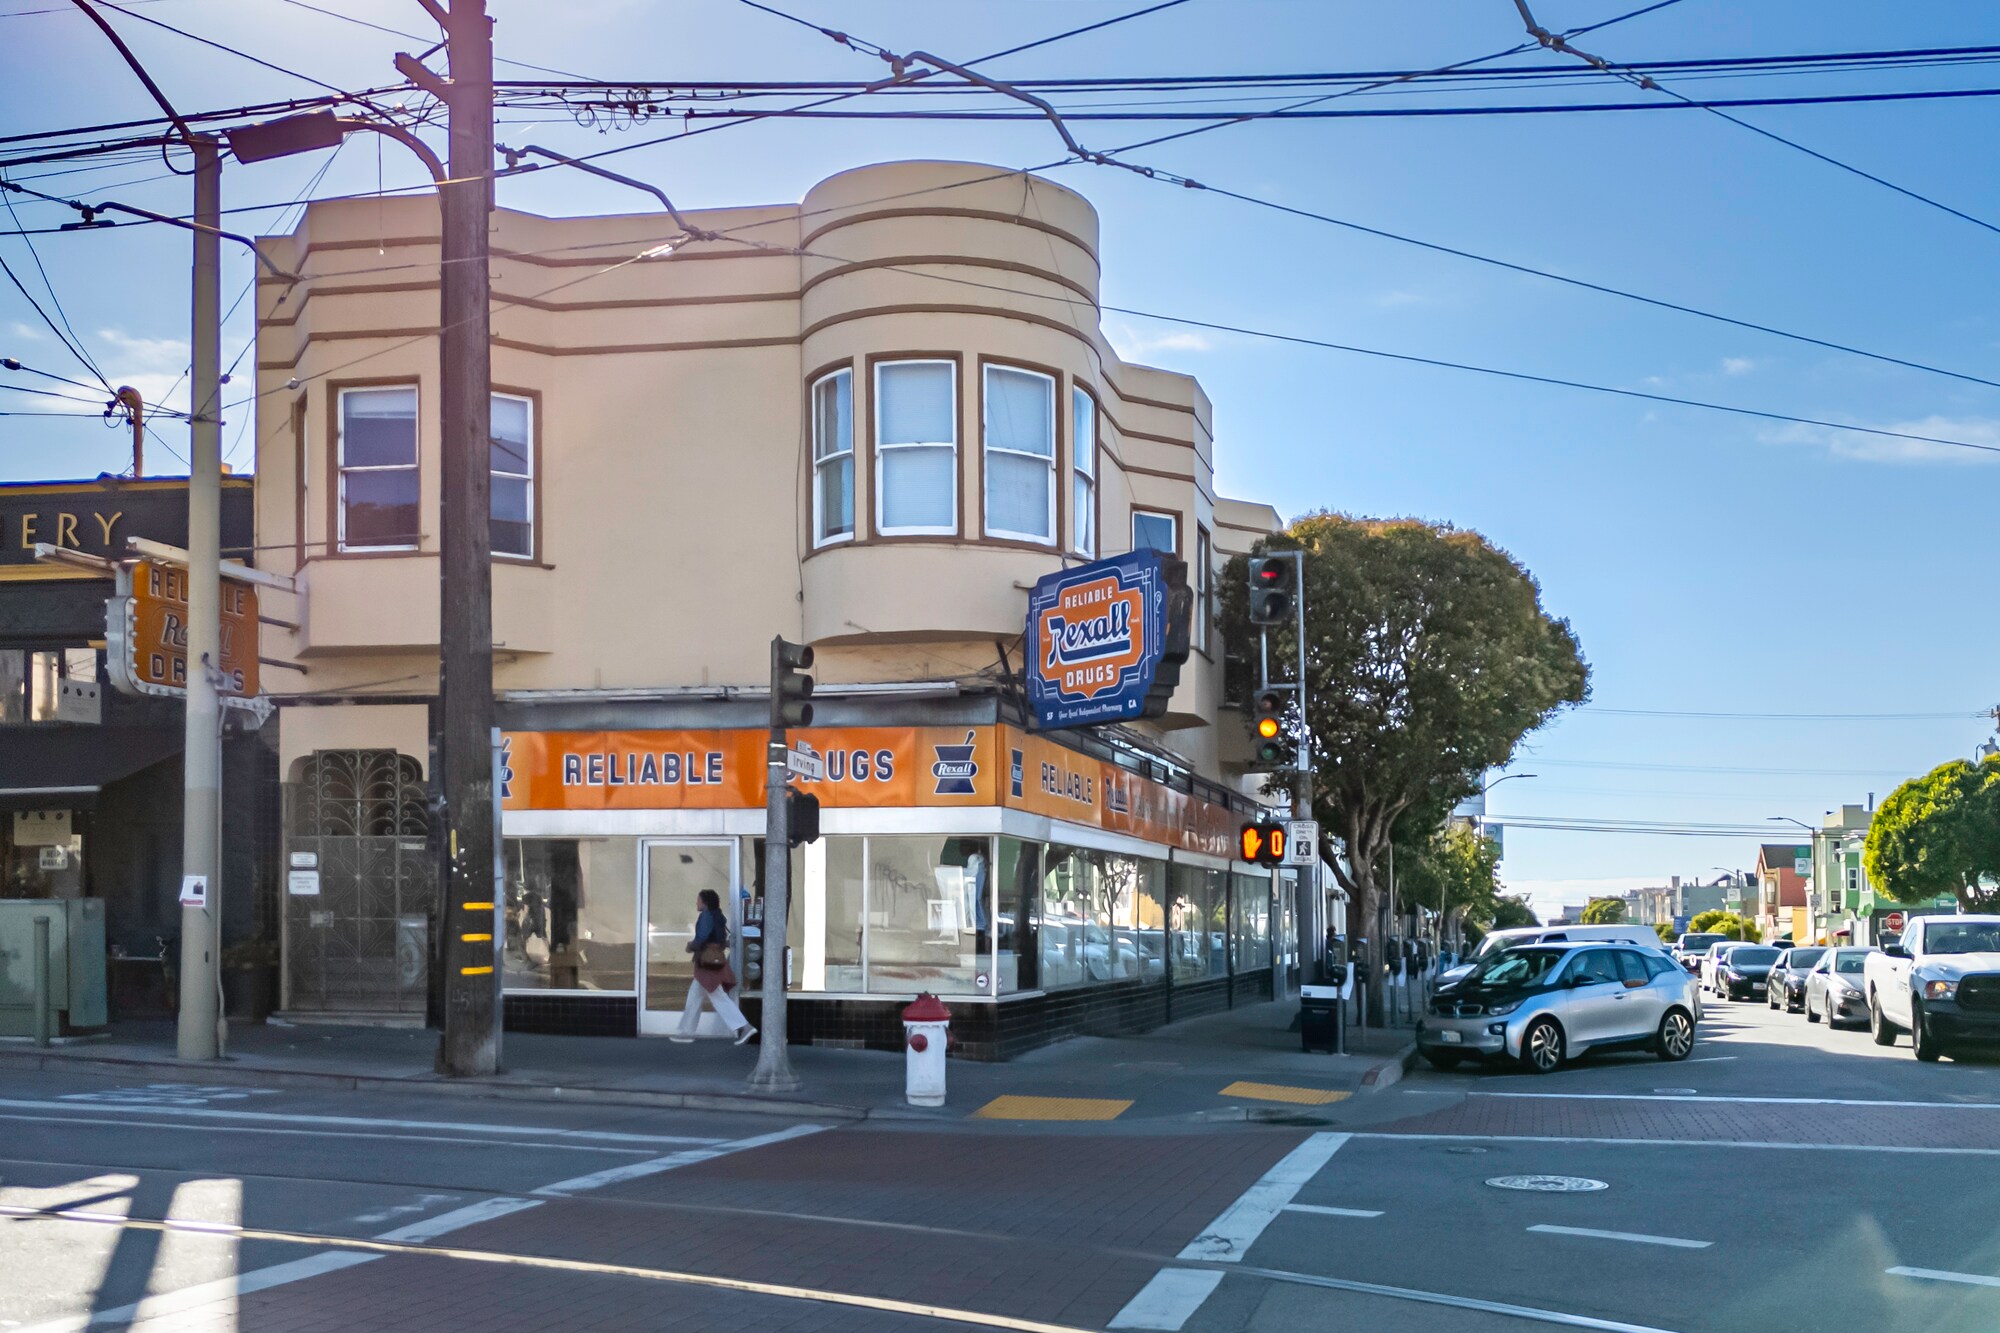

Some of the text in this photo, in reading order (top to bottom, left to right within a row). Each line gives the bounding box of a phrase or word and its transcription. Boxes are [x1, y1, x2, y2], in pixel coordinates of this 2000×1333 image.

[150, 567, 245, 617] RELLE
[1065, 586, 1113, 609] RELIABLE
[1047, 600, 1132, 669] Rexall
[151, 653, 245, 692] DRS
[1066, 664, 1114, 688] DRUGS
[1128, 699, 1137, 709] CA
[563, 749, 894, 786] RELIABLE UGS
[793, 753, 815, 776] Irving
[938, 763, 972, 776] Rexall
[1041, 760, 1093, 806] RELIABLE
[1271, 830, 1283, 857] 0
[1887, 918, 1903, 926] STOP
